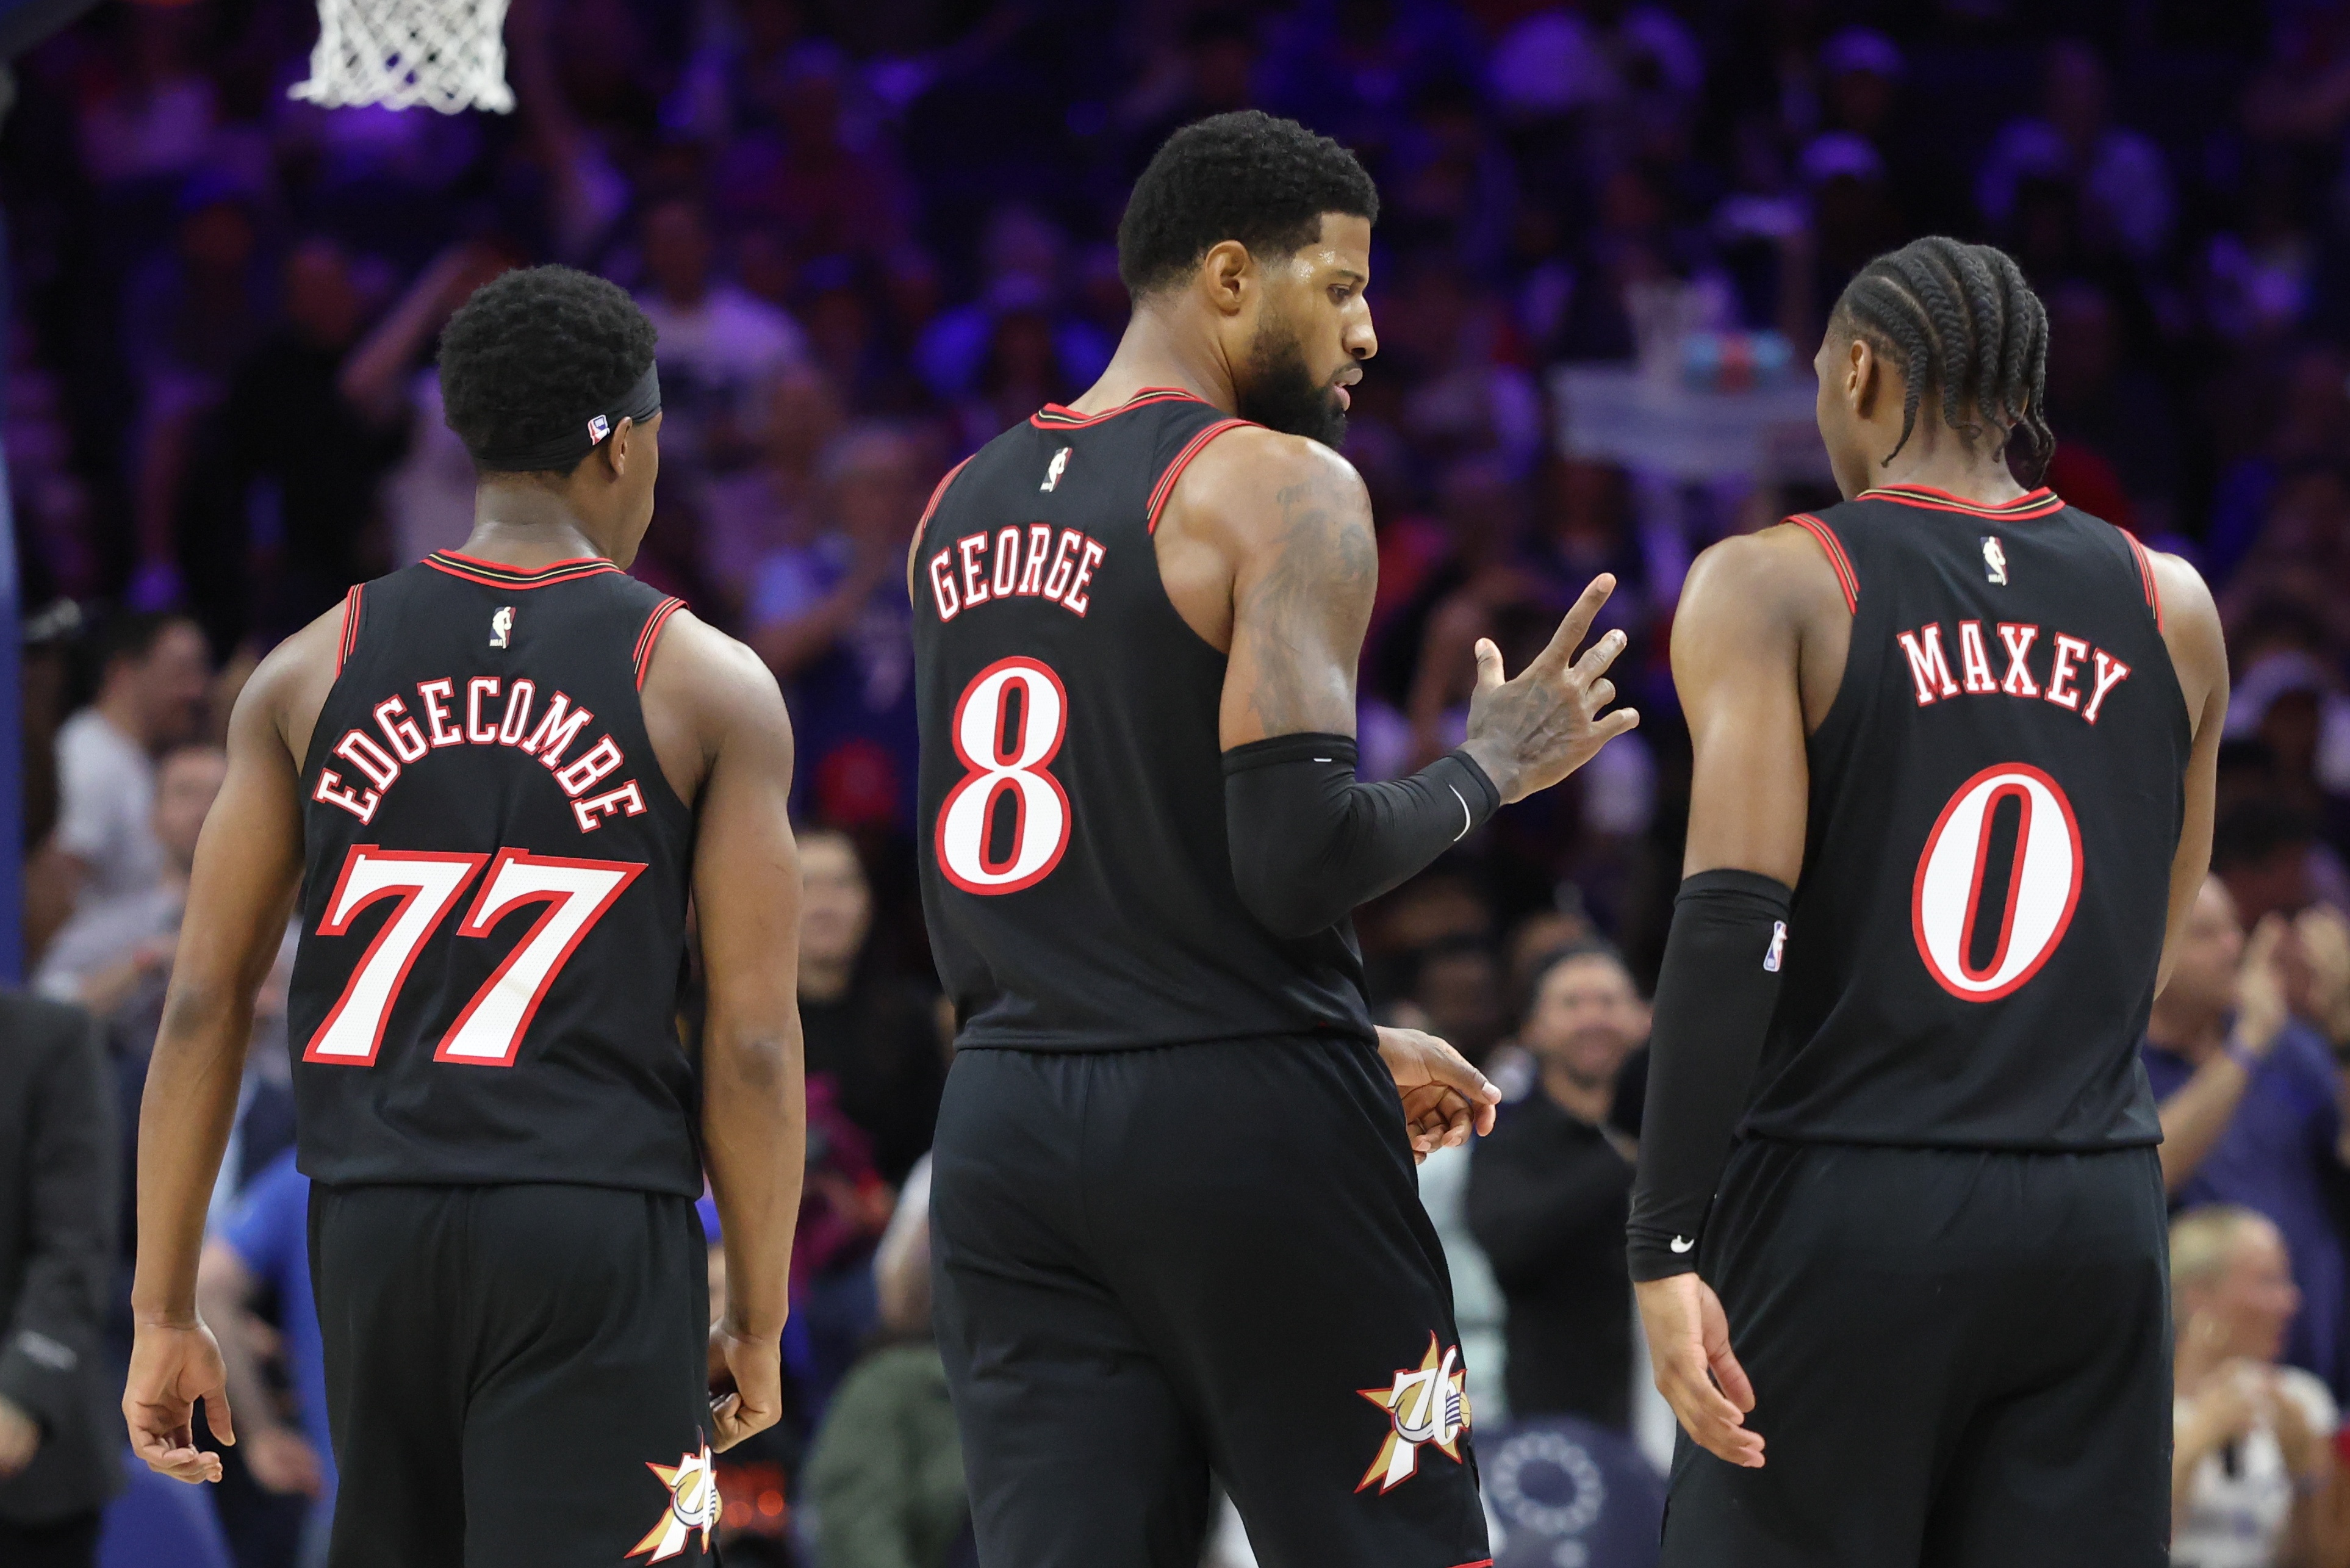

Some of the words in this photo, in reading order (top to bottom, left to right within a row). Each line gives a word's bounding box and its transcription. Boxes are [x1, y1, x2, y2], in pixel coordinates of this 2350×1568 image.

[929, 524, 1107, 622] GEORGE
[1897, 620, 2130, 725] MAXEY
[313, 677, 647, 833] EDGECOMBE
[935, 656, 1071, 895] 8
[303, 844, 648, 1067] 77
[1912, 762, 2083, 1002] 0
[1380, 1345, 1460, 1494] 76
